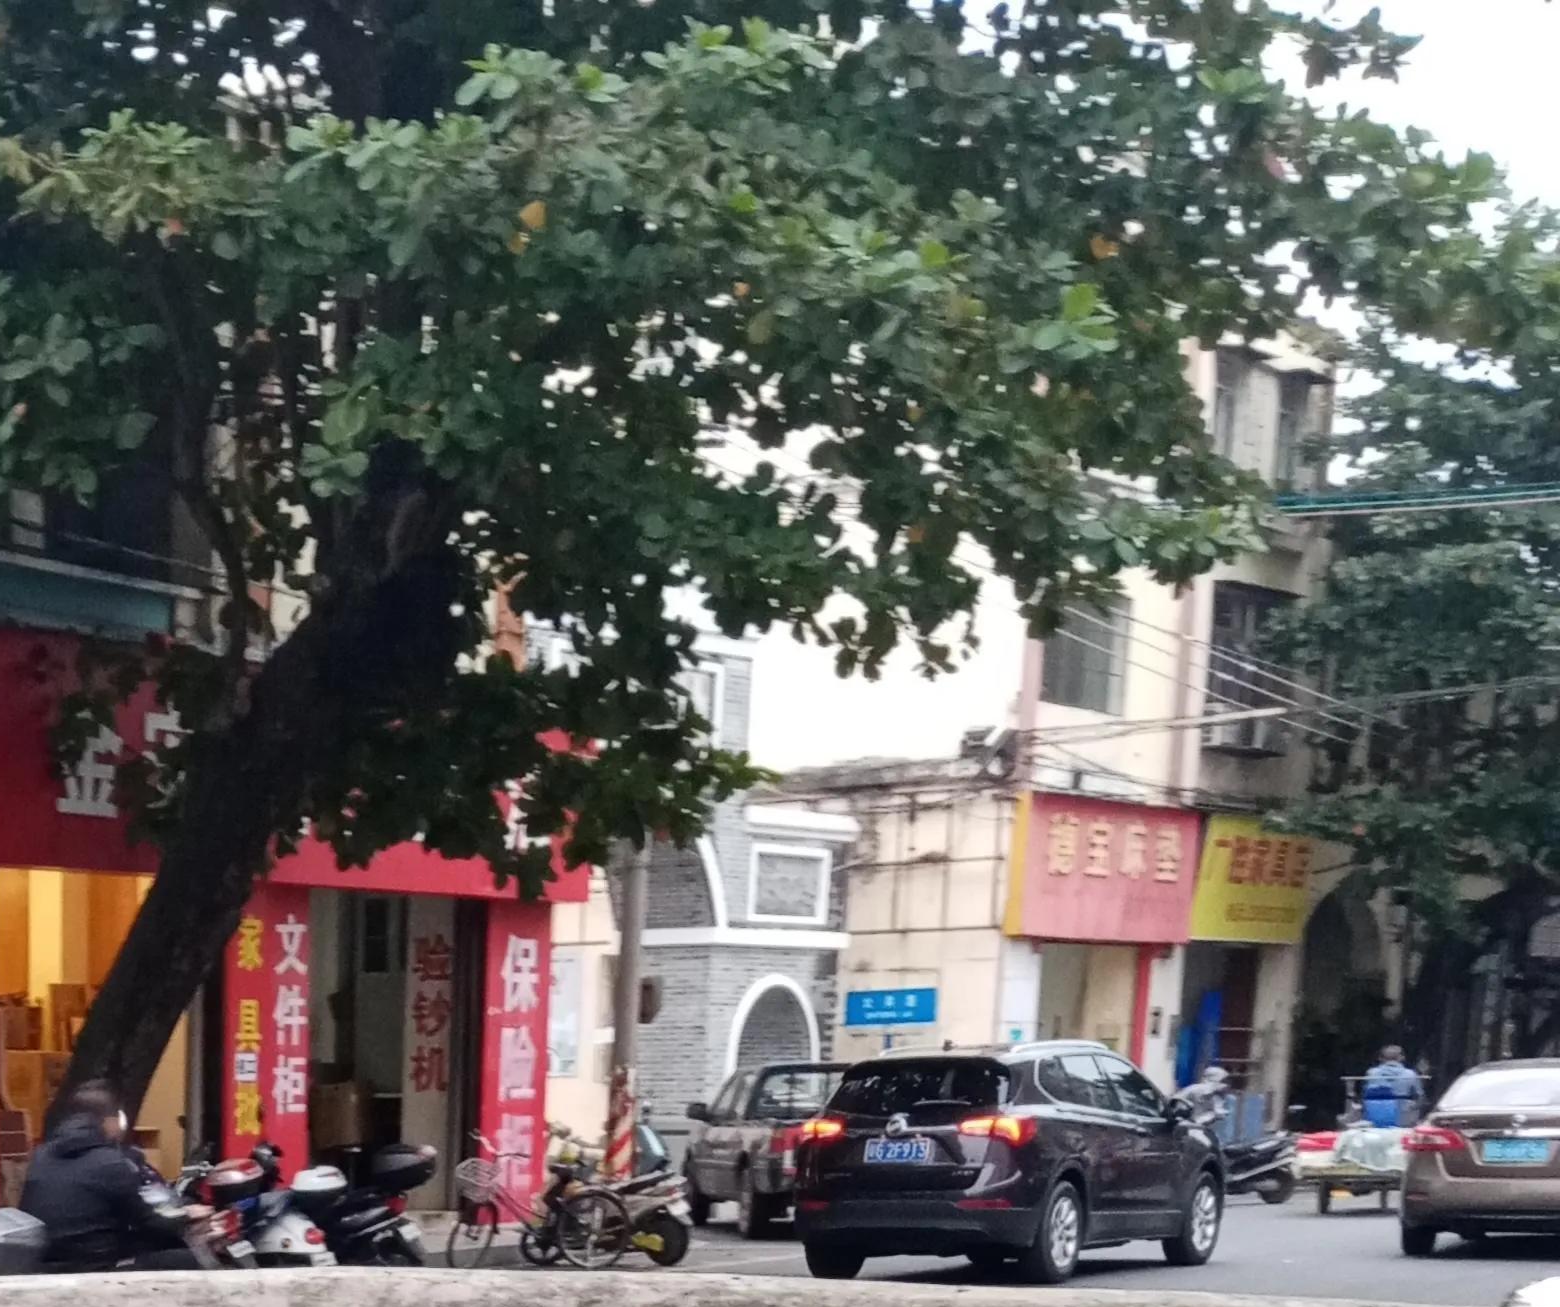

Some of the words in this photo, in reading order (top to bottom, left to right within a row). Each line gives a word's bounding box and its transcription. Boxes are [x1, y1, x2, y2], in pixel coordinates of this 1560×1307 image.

[271, 912, 309, 1116] 文件柜
[410, 932, 452, 1093] 验钞机
[495, 934, 540, 1190] 保险柜
